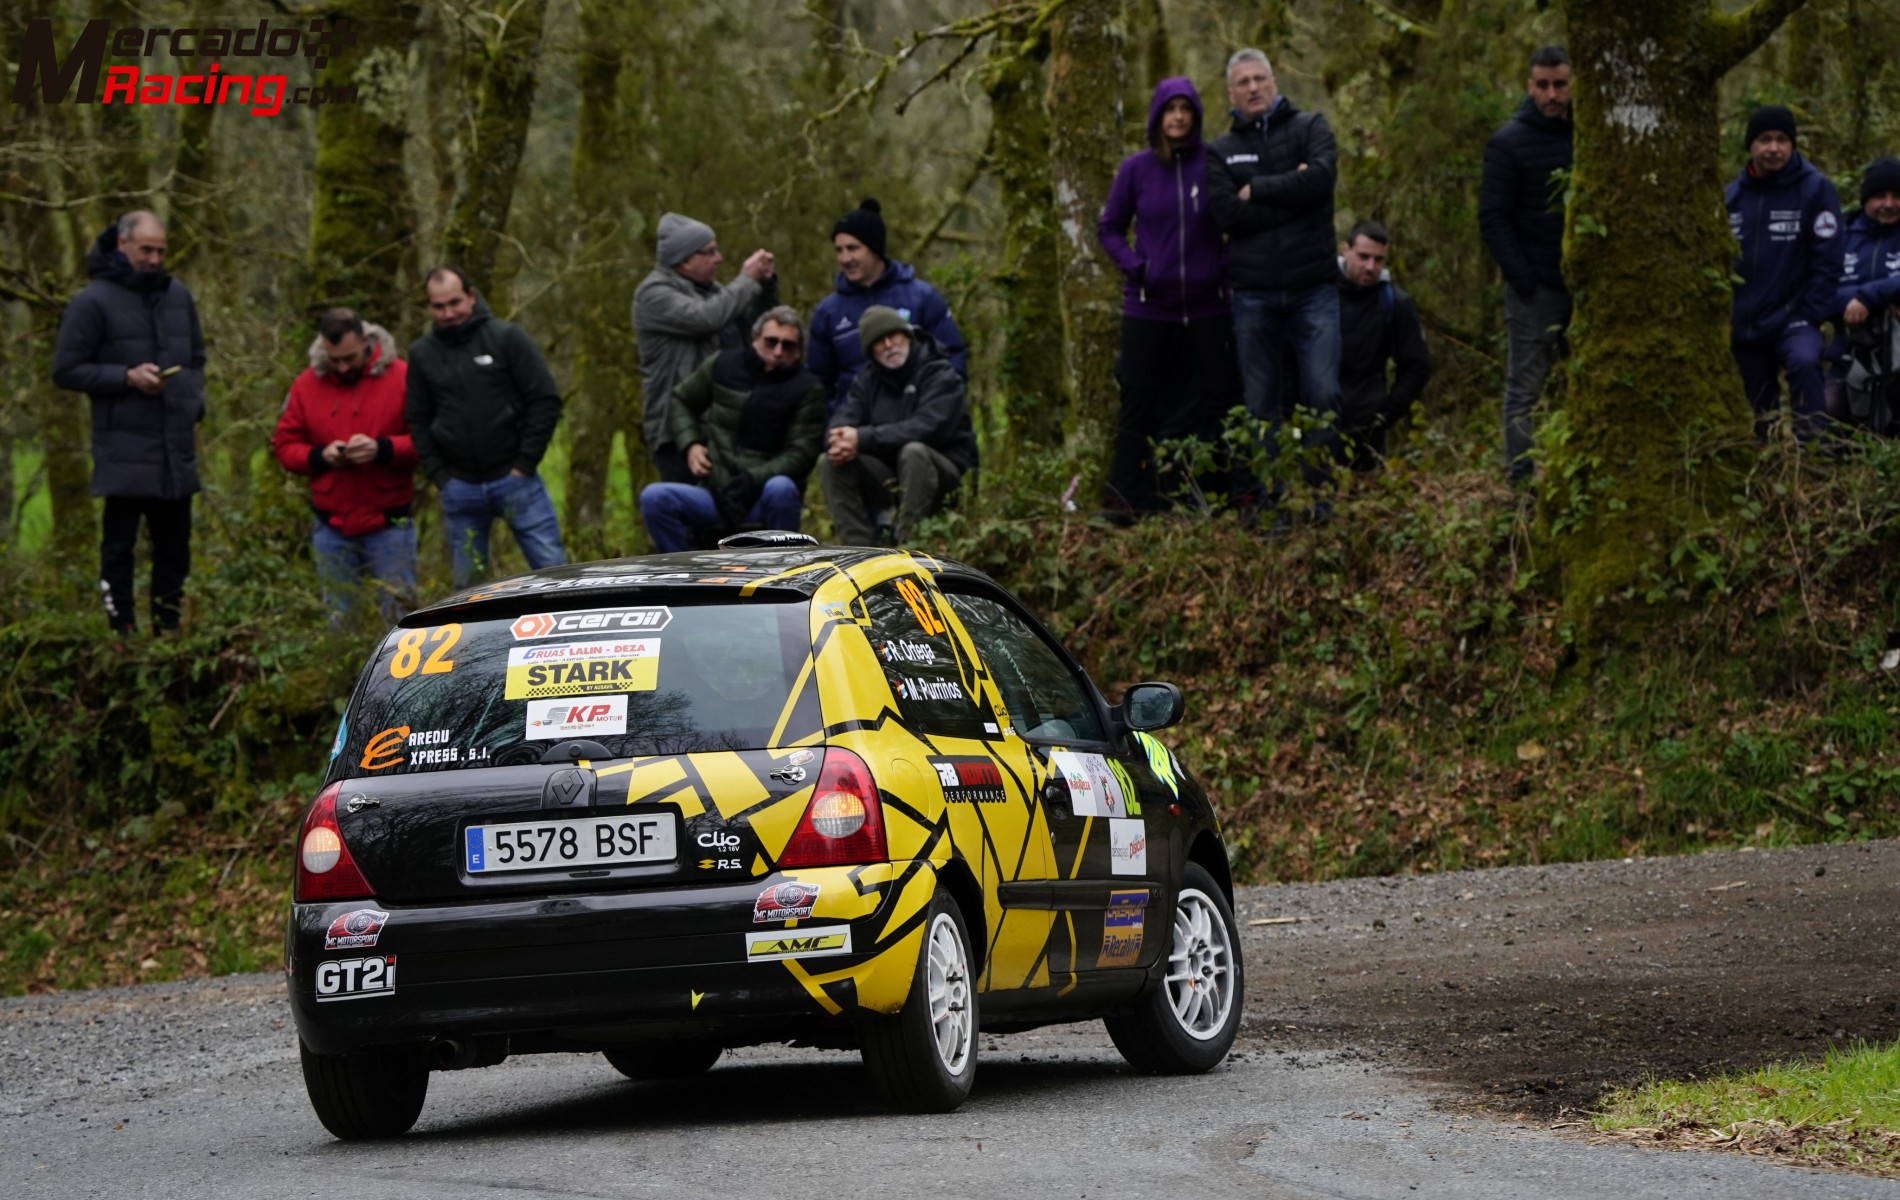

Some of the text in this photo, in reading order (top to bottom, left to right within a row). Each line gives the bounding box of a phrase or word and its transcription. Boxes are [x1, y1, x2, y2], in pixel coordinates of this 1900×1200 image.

[895, 578, 946, 636] 82
[558, 611, 662, 630] ceroil
[390, 622, 463, 679] 82
[523, 645, 567, 659] GRUAS
[569, 646, 602, 656] LALIN
[614, 644, 646, 653] DEZA
[886, 639, 936, 665] R. Ortega
[527, 660, 634, 686] STARK
[905, 677, 924, 700] M.
[547, 704, 611, 724] SKP
[408, 729, 450, 747] AREDU
[410, 747, 458, 765] XPRESS
[944, 790, 1006, 801] PERFORMANCE
[1106, 757, 1142, 816] 82
[472, 821, 659, 863] E 5578 BSF
[697, 831, 741, 848] Clio
[717, 859, 742, 870] R.S.
[755, 906, 812, 919] MC MOTORSPORT
[337, 934, 378, 945] MOTORSPORT
[317, 956, 395, 994] GT2i
